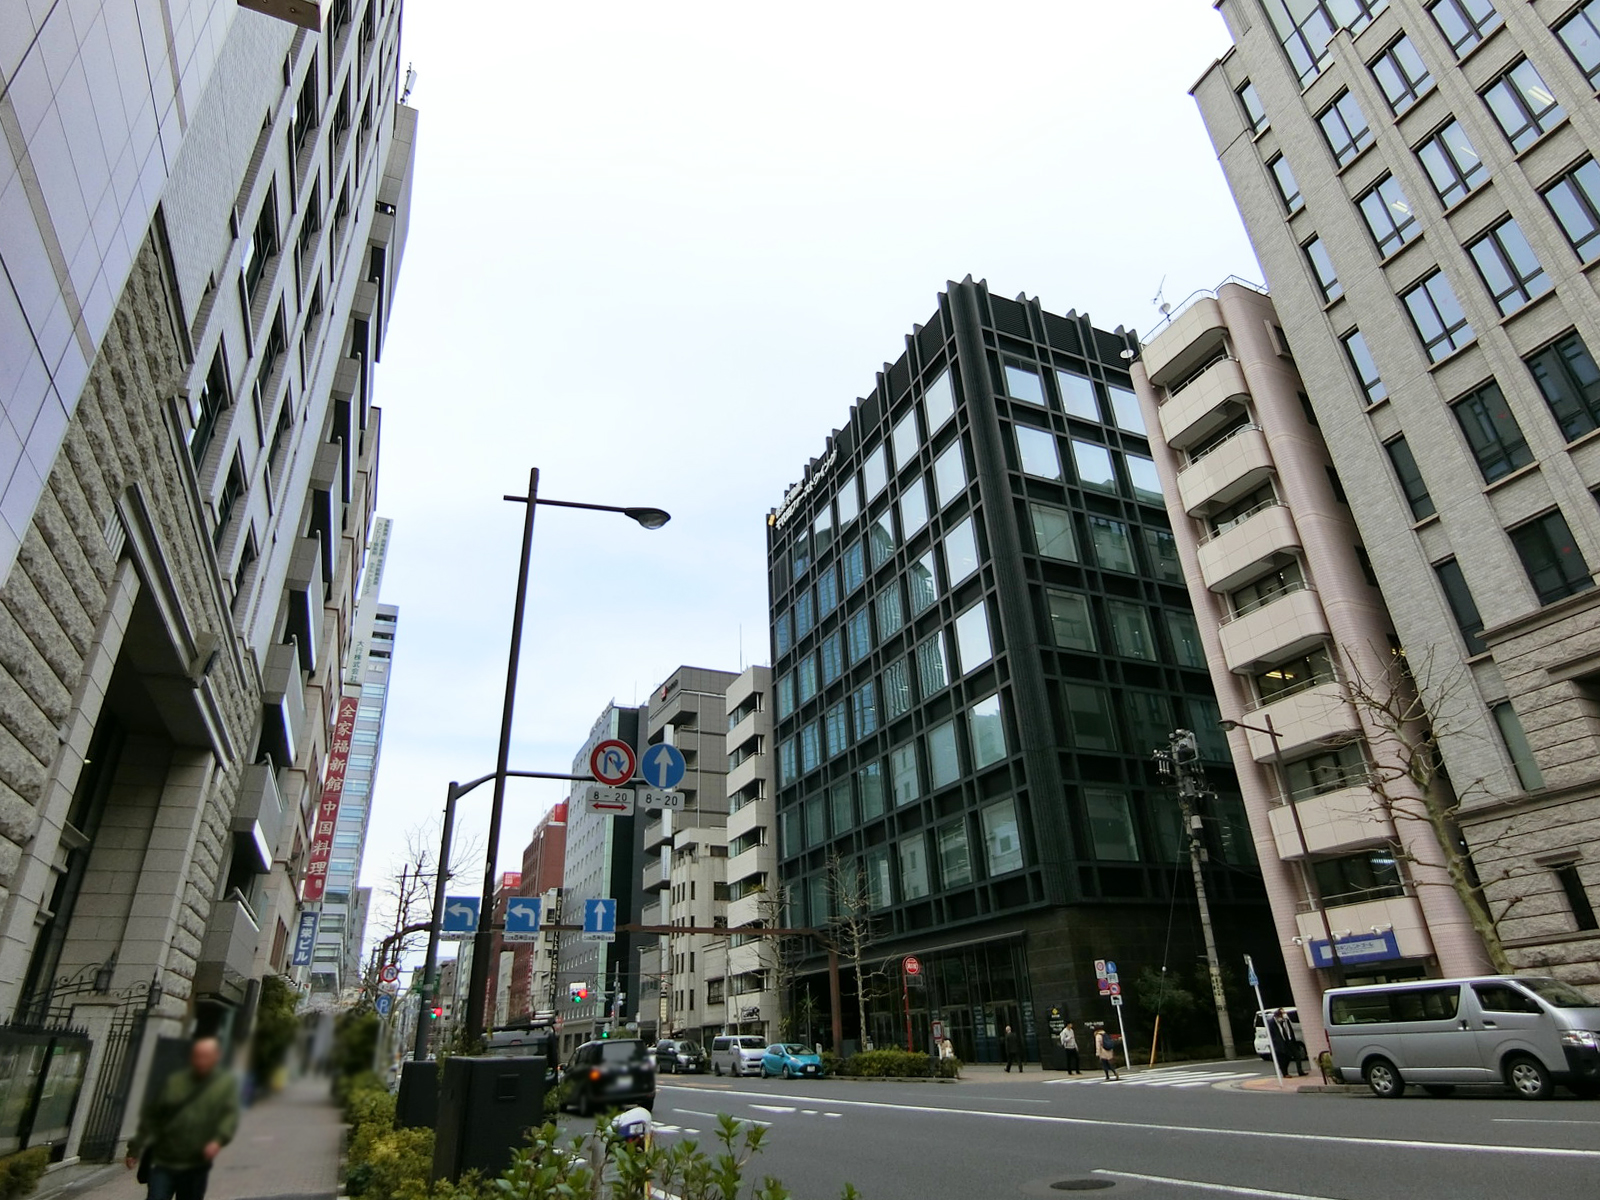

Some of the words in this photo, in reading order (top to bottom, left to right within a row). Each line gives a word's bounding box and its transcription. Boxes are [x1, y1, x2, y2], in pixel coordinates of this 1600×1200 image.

[325, 702, 357, 793] 全家福新館
[308, 799, 338, 877] 中国料理
[295, 914, 316, 962] 宝栄ビル
